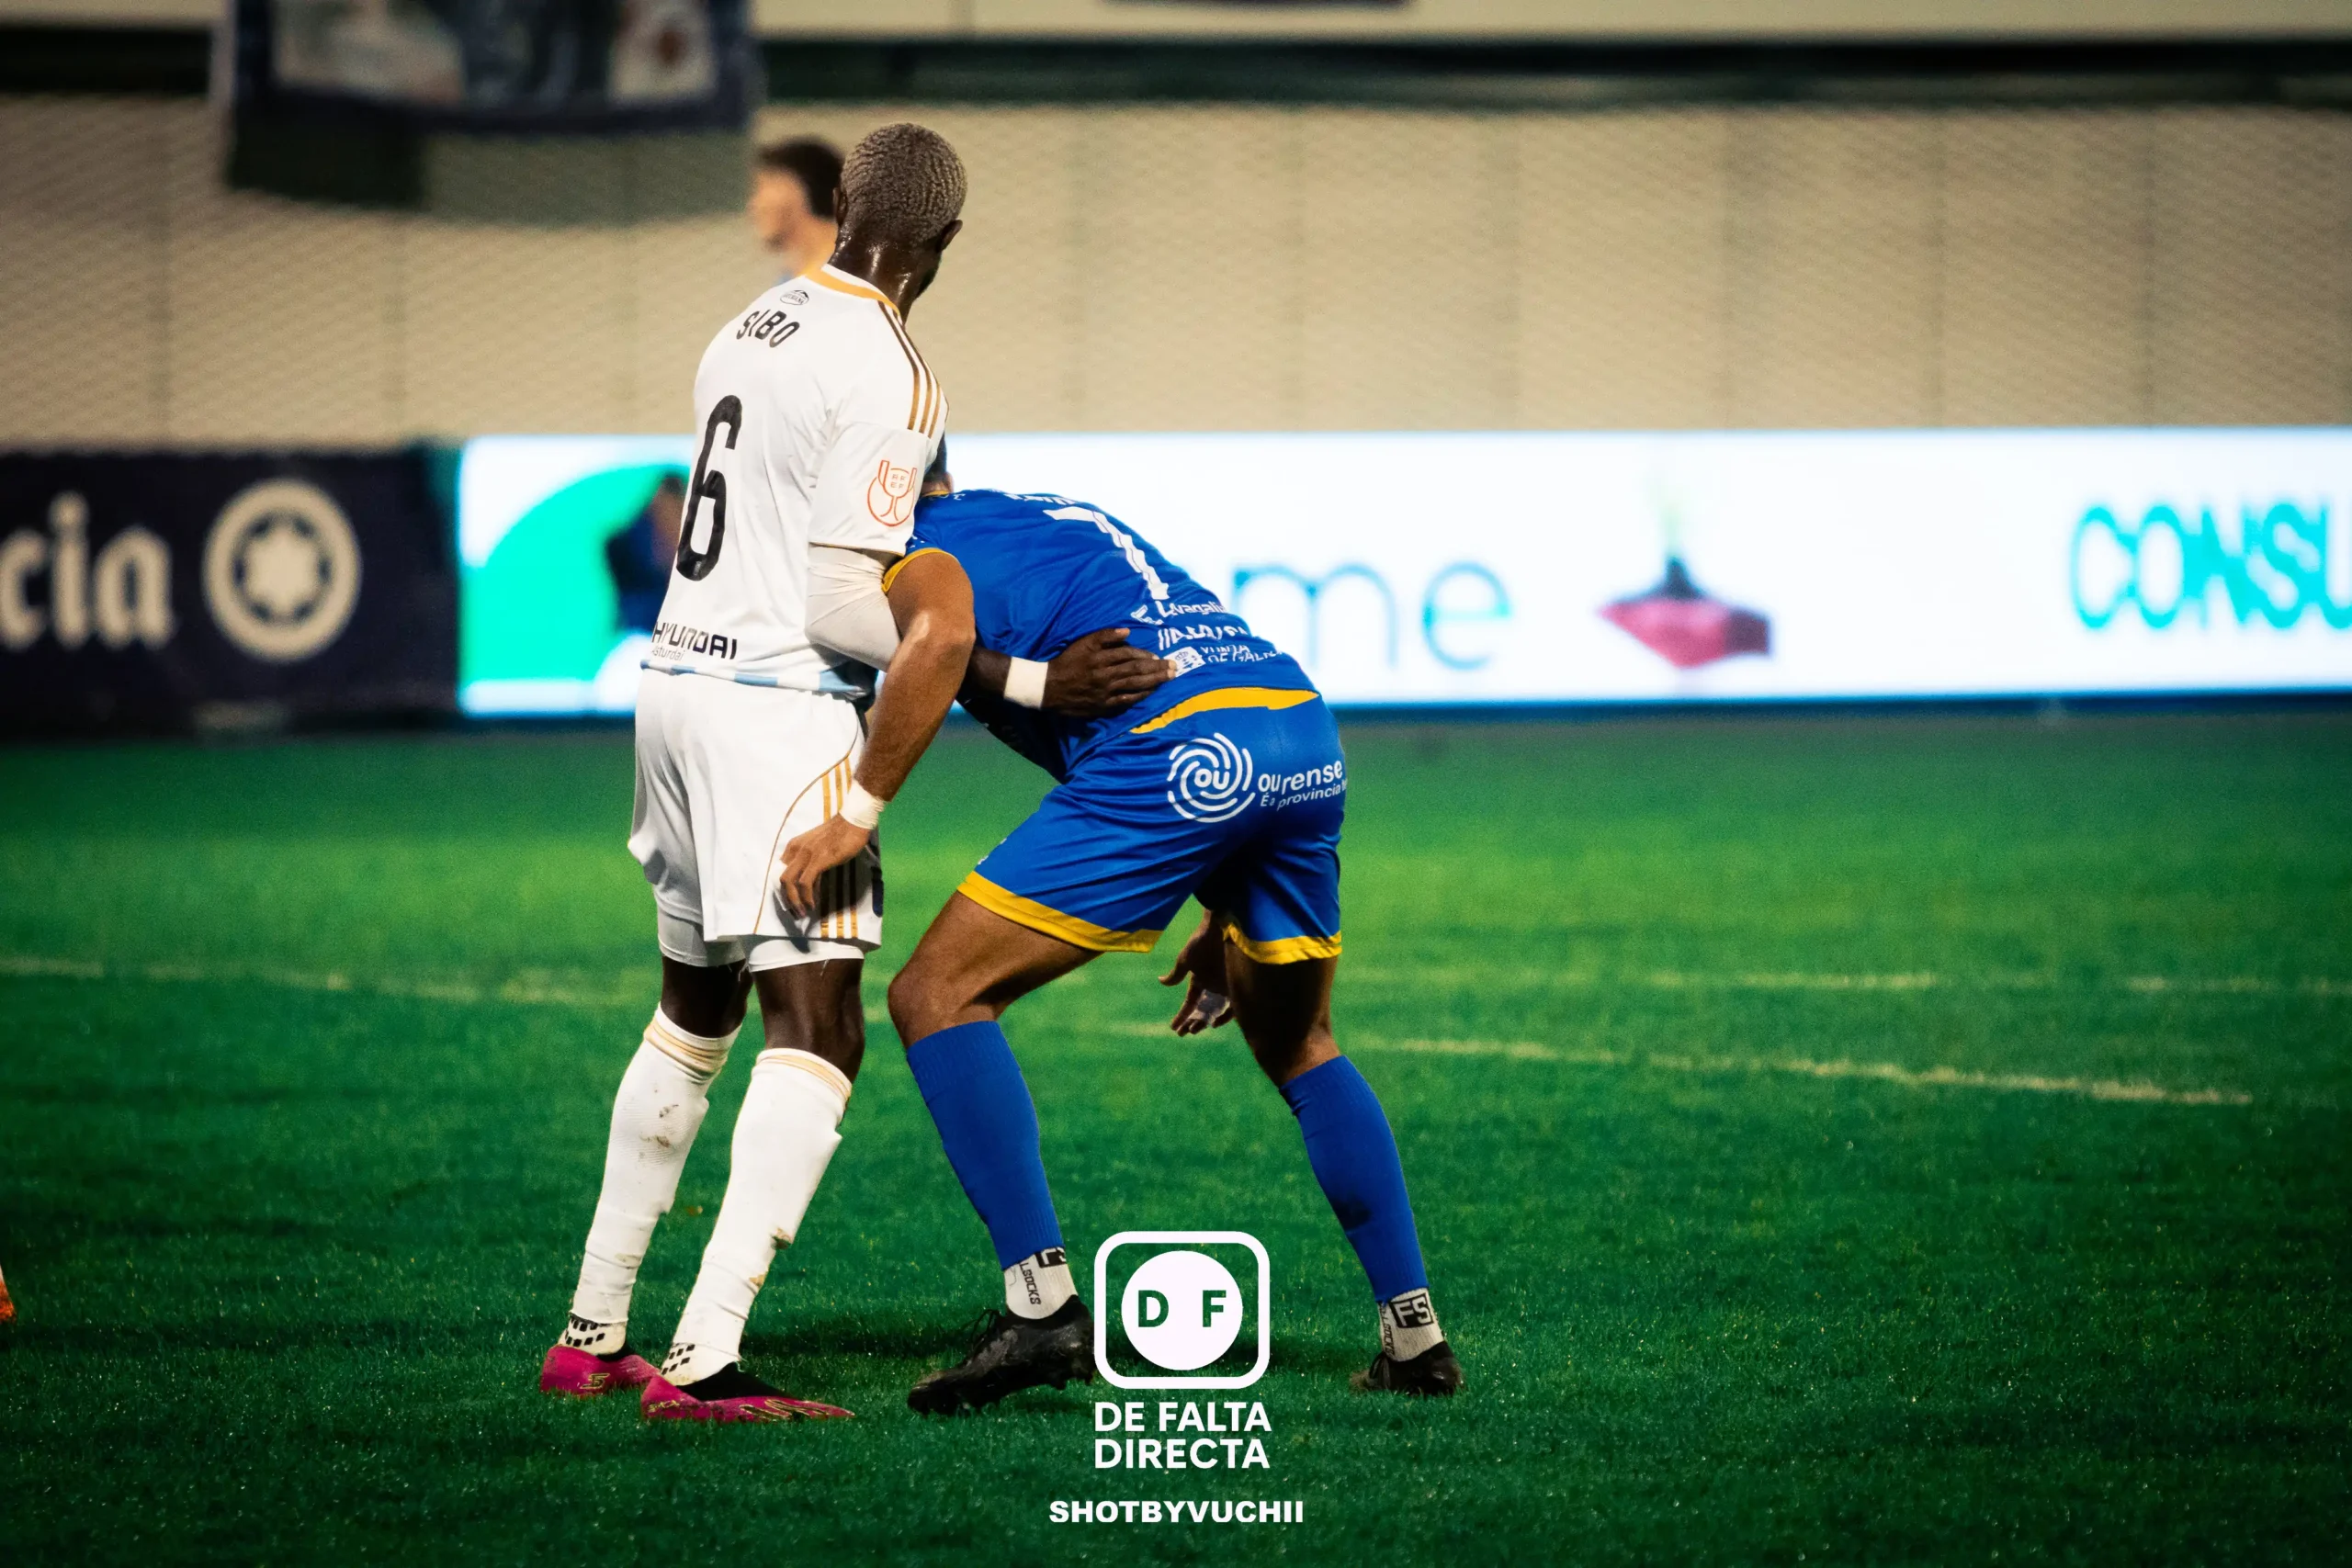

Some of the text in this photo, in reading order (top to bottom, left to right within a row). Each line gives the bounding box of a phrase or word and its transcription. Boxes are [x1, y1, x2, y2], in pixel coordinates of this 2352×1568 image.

[736, 309, 800, 348] SIBO
[675, 394, 742, 581] 6
[651, 622, 738, 660] HYUNDAI
[1276, 785, 1341, 811] provincia
[1393, 1296, 1431, 1327] FS
